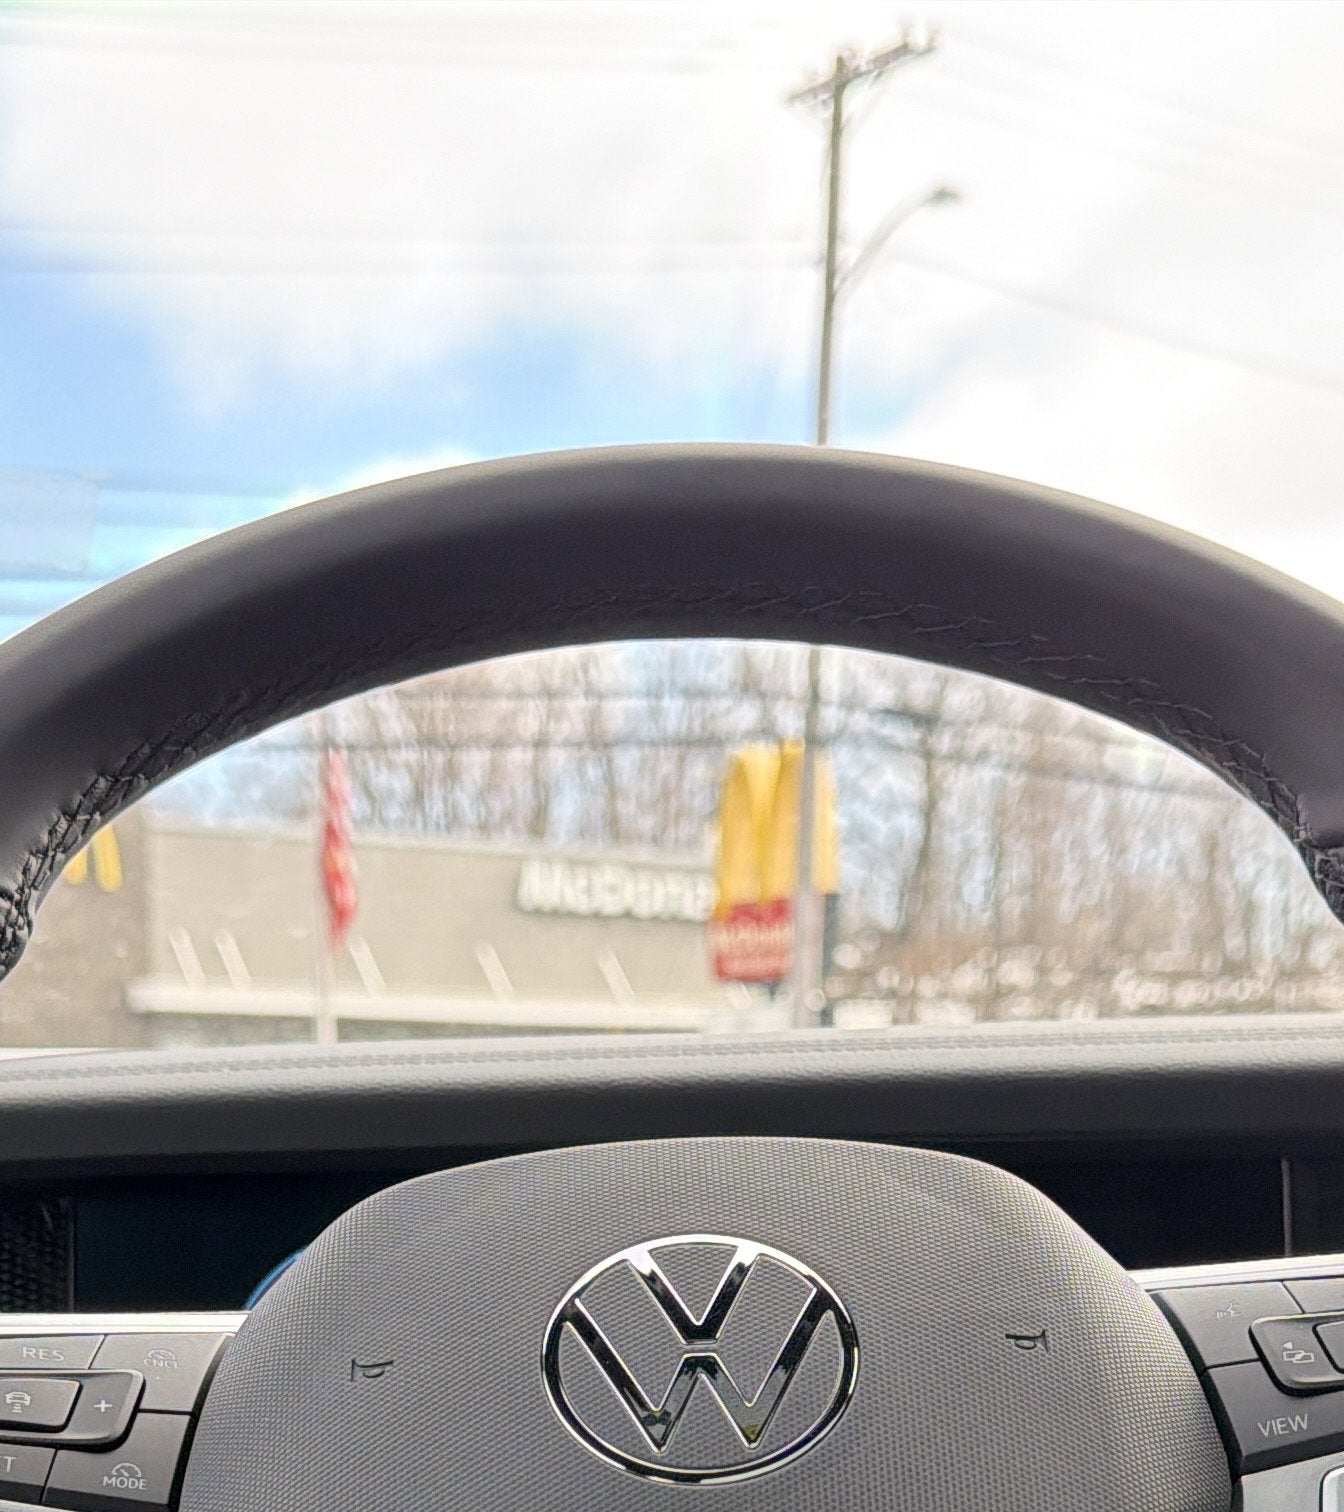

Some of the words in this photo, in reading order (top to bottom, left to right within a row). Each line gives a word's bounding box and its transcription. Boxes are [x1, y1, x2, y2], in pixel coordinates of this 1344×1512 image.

[22, 1346, 65, 1362] RES
[1257, 1412, 1309, 1438] VIEW
[102, 1475, 148, 1490] MODE
